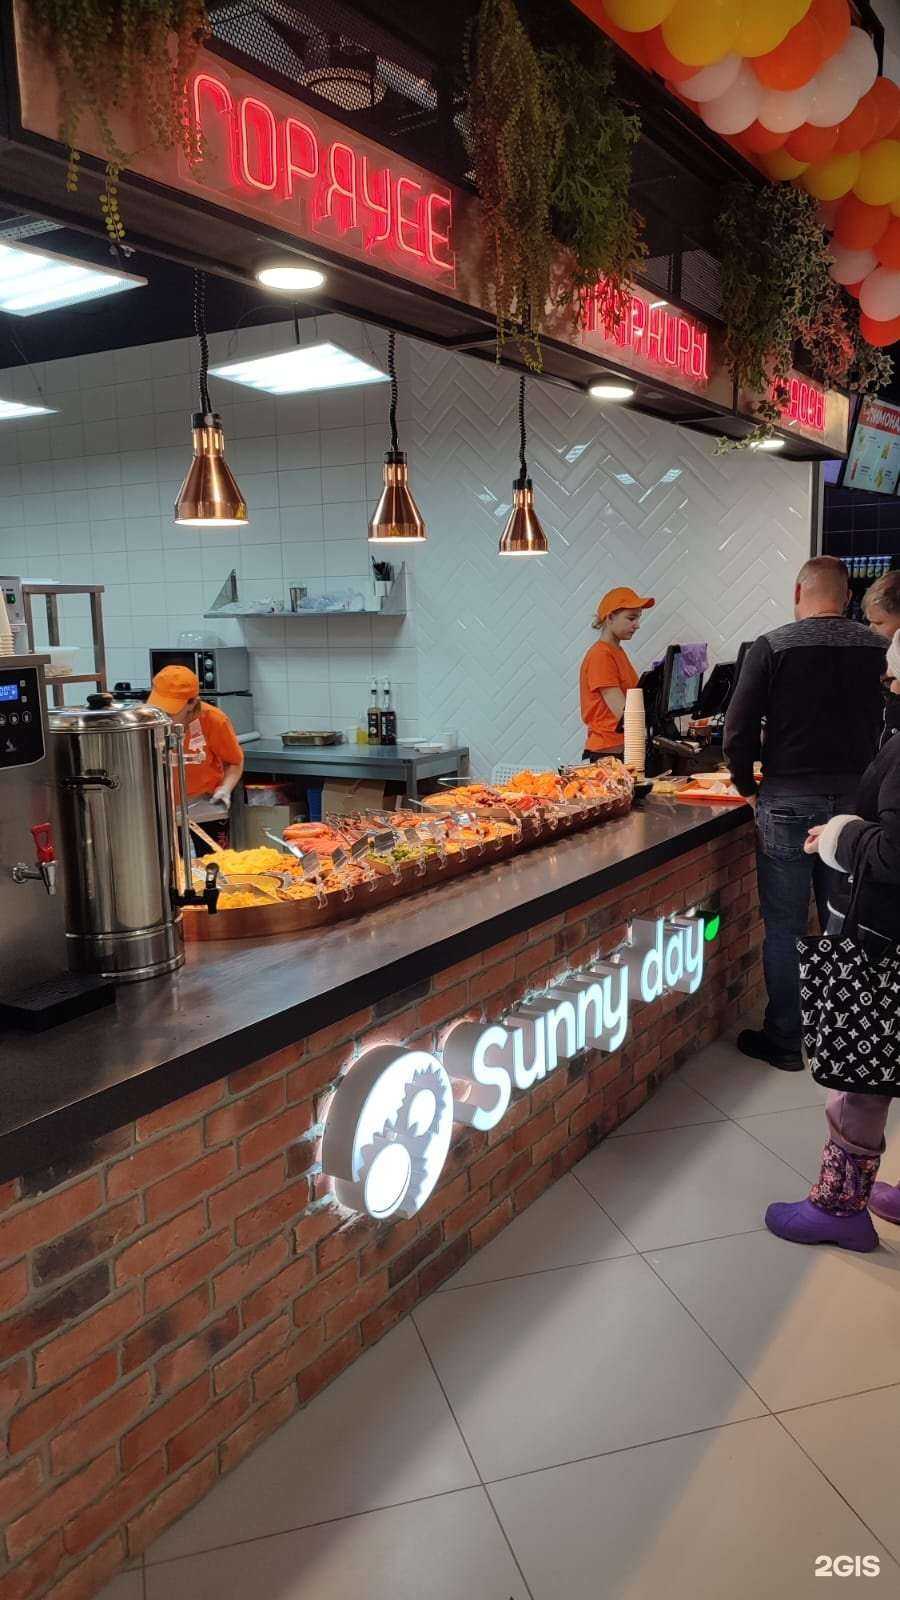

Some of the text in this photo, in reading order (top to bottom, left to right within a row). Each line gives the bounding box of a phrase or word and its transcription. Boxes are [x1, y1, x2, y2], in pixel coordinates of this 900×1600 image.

[193, 73, 453, 269] ГОРЯЧЕЕ
[472, 916, 704, 1131] Sunny day
